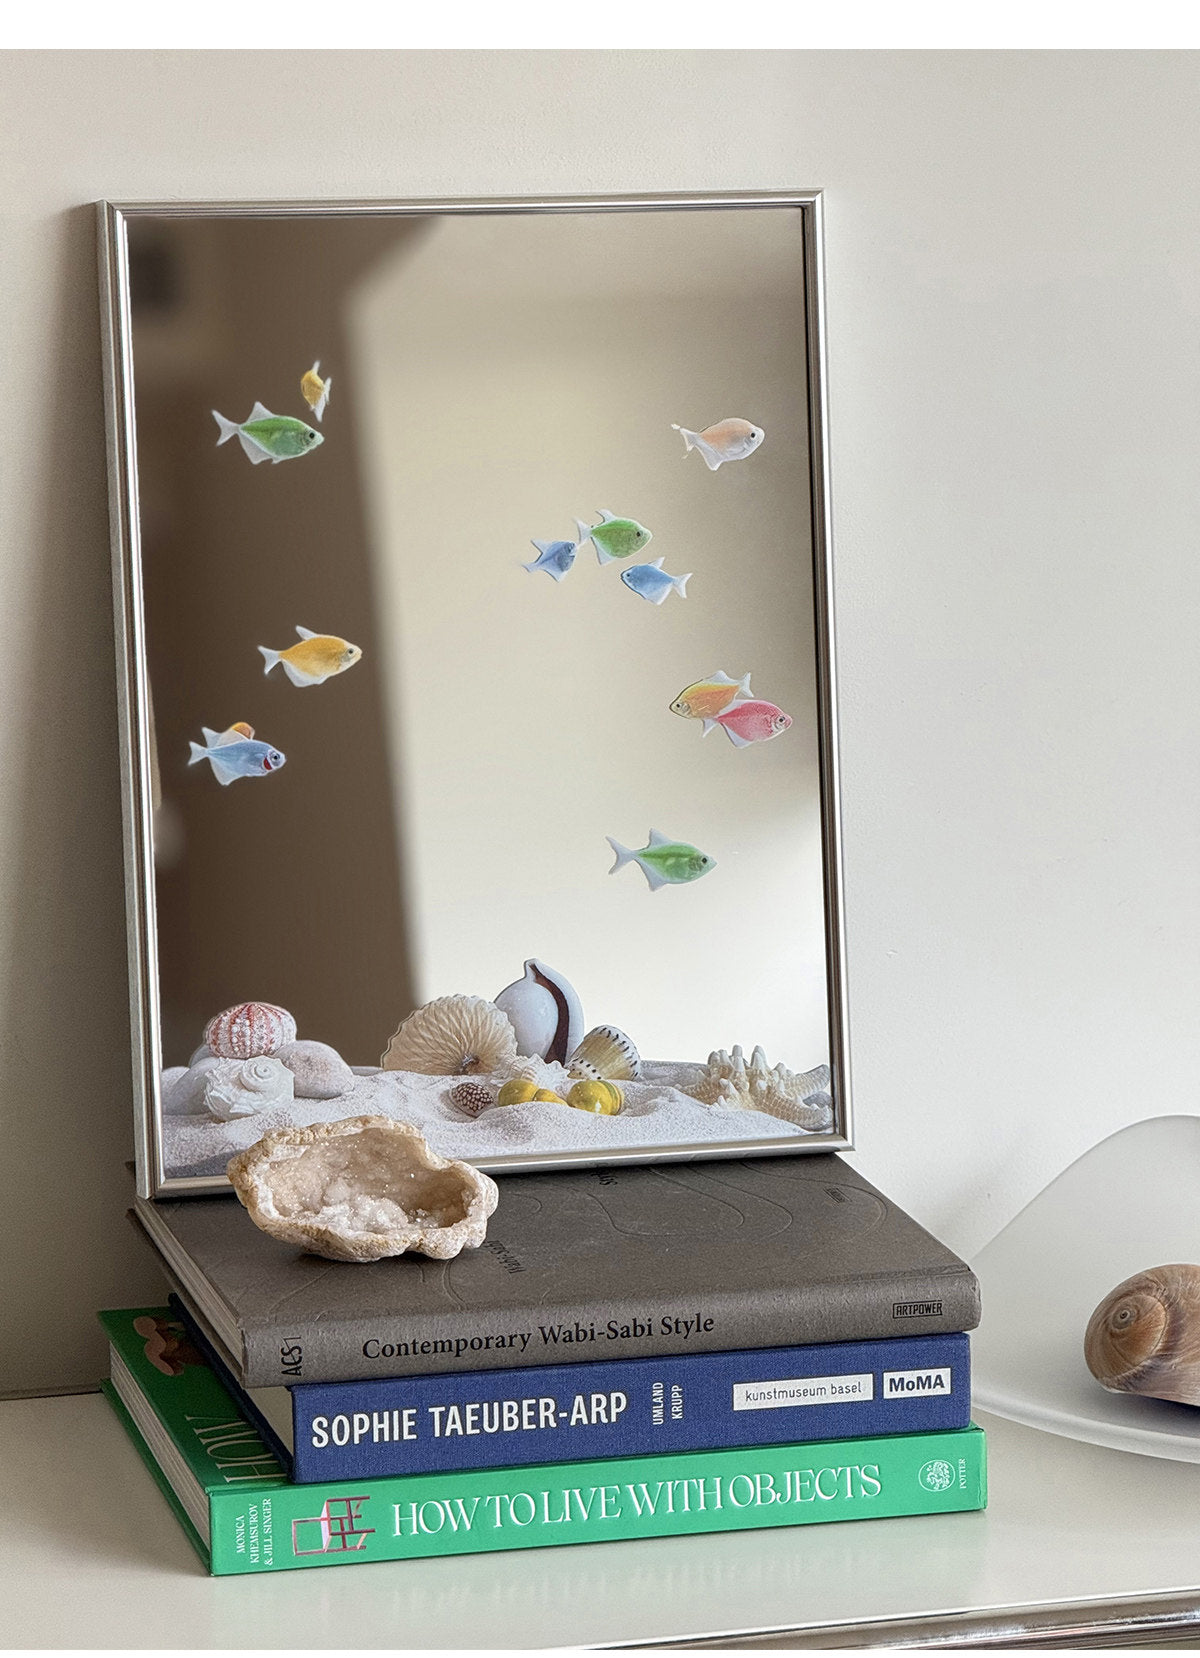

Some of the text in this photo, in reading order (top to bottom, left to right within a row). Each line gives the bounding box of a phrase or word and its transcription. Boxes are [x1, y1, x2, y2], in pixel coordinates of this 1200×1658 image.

[896, 1302, 943, 1316] ARTPOWER
[362, 1312, 714, 1359] Contemporary Wabi-Sabi Style
[652, 1381, 665, 1425] UMLAND
[671, 1384, 684, 1419] KRUPP
[745, 1381, 862, 1401] kunstmuseum basel
[888, 1373, 945, 1393] MoMA
[311, 1391, 628, 1448] SOPHIE TAEUBER-ARP
[958, 1458, 967, 1489] POTTER
[392, 1464, 882, 1537] HOW TO LIVE WITH OBJECTS
[235, 1514, 246, 1554] MONICA
[248, 1504, 260, 1564] KHEMSUROV
[262, 1498, 273, 1566] & JILL SINGER
